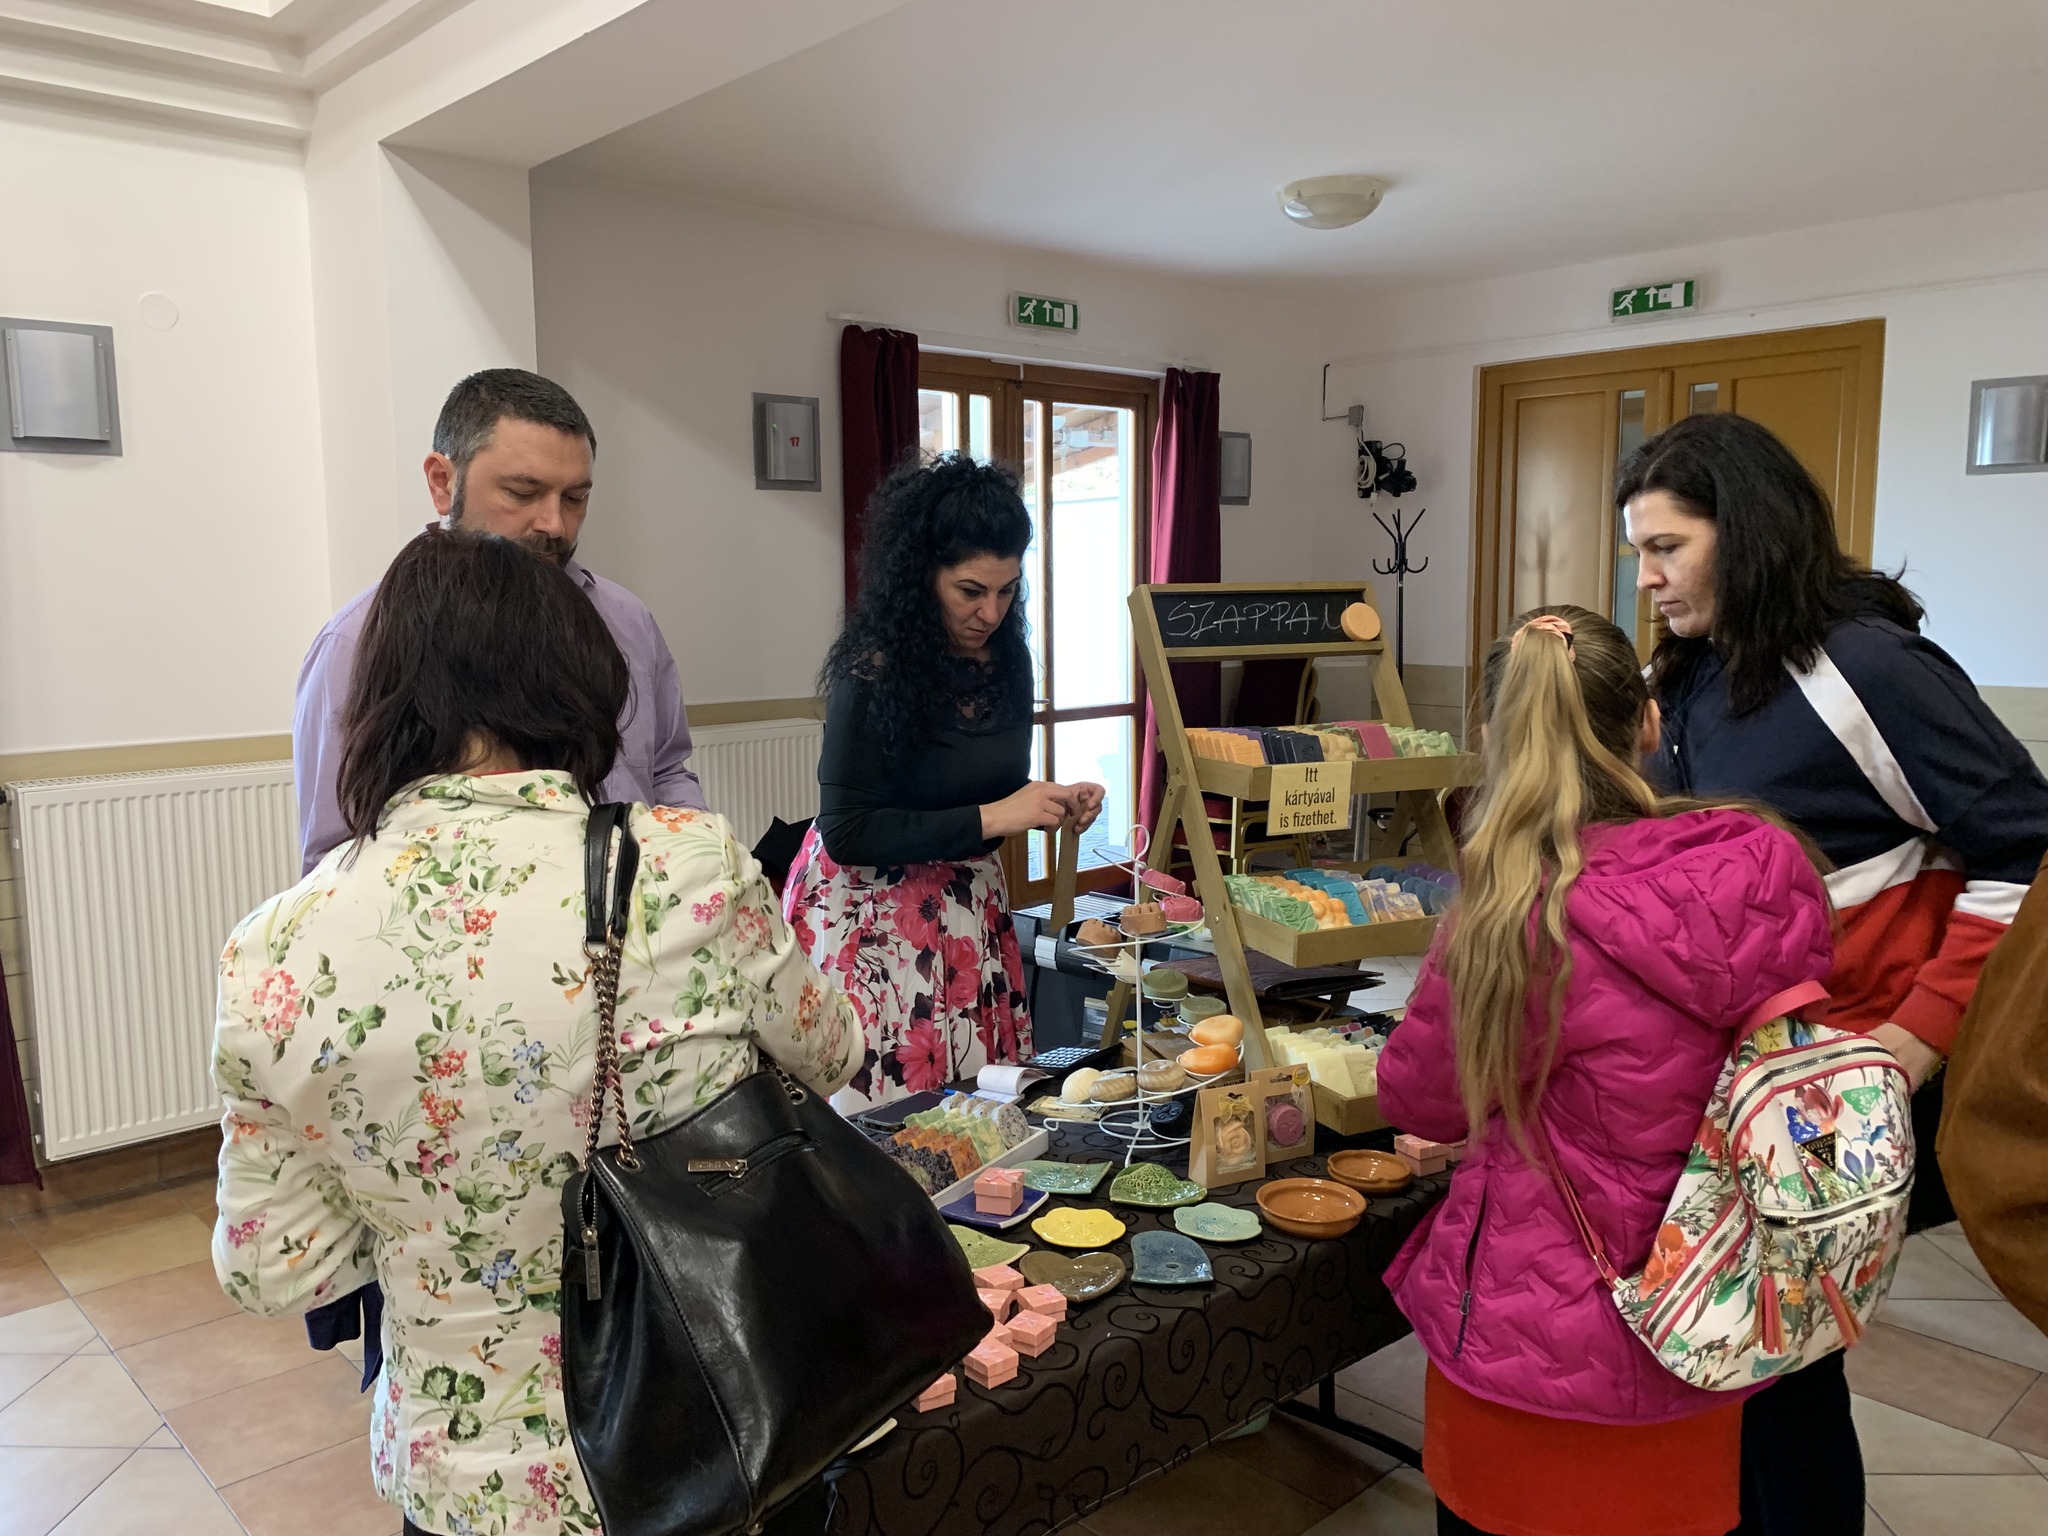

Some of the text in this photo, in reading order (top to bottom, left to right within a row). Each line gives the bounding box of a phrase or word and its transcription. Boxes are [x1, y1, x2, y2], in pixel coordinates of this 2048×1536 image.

[1305, 766, 1319, 783] Itt
[1284, 786, 1336, 807] kártyával
[1280, 809, 1337, 828] is fizethet.
